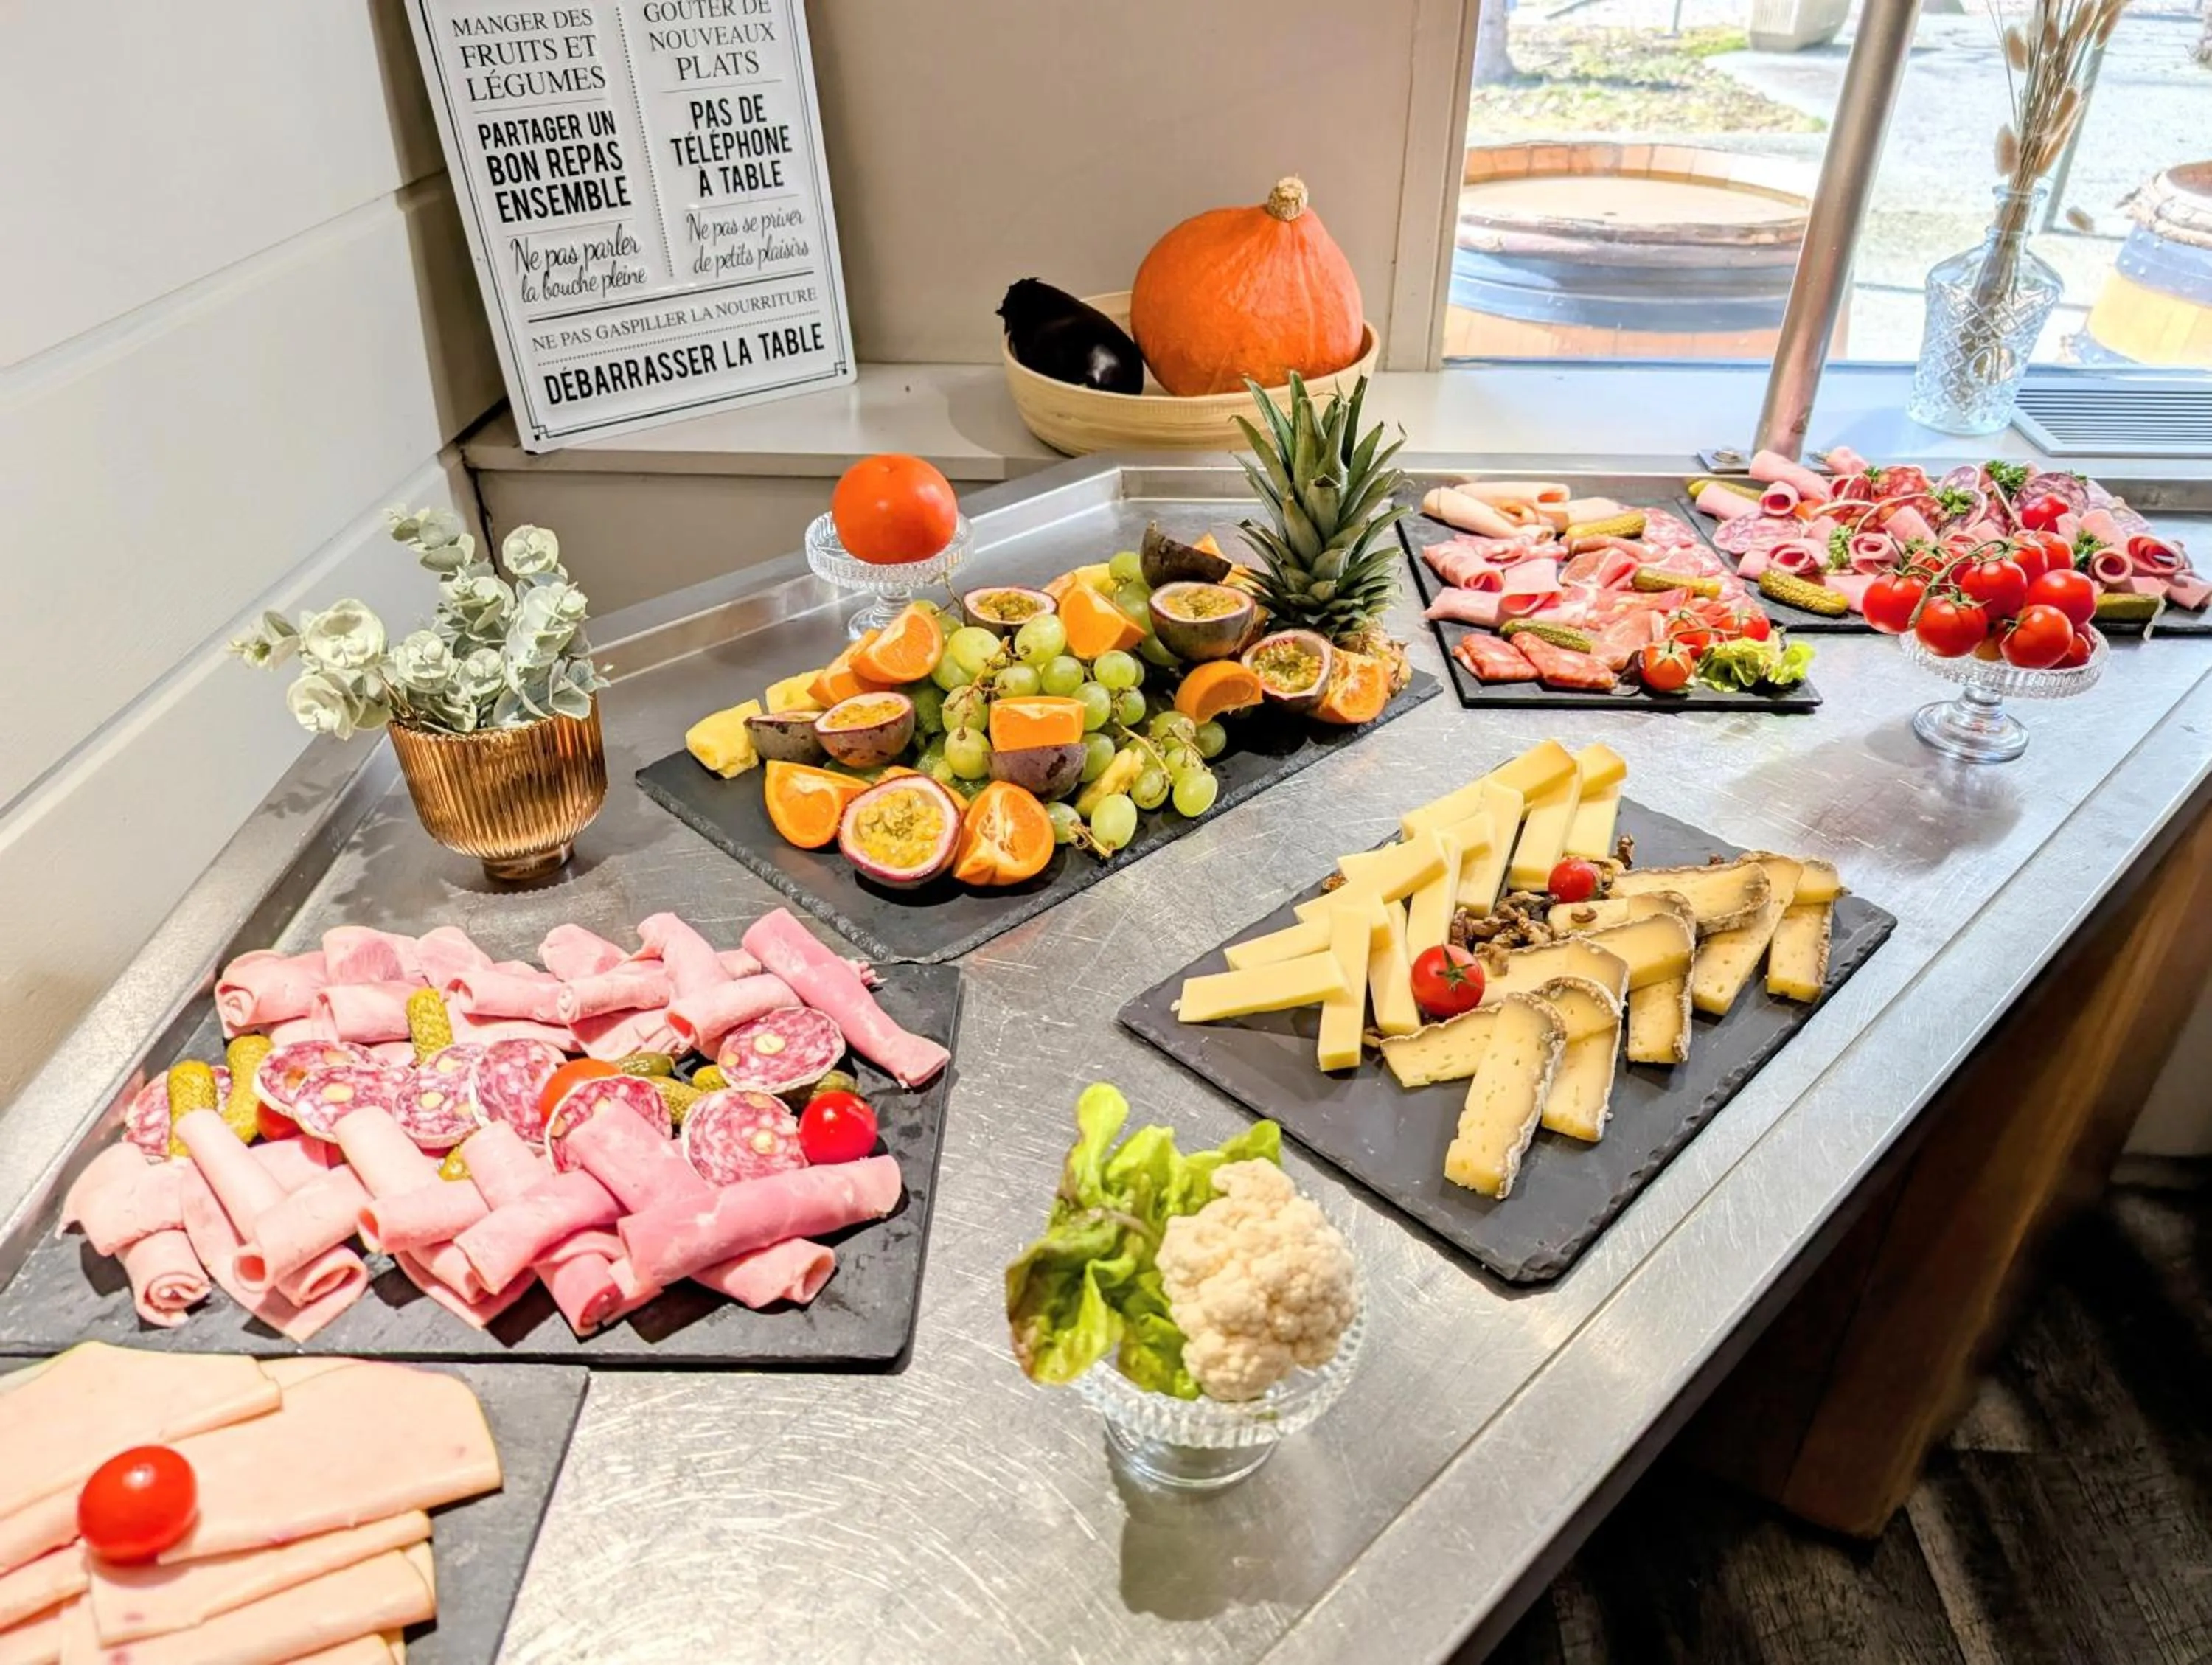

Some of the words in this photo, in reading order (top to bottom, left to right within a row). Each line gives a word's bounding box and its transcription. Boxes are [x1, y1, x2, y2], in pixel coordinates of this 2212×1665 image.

[451, 12, 549, 37] MANGER
[553, 8, 594, 29] DES
[742, 0, 772, 14] DE
[459, 38, 558, 69] FRUITS
[564, 35, 597, 59] ET
[649, 22, 776, 51] NOUVEAUX
[465, 66, 606, 102] LÉGUMES
[675, 50, 760, 81] PLATS
[477, 114, 583, 150] PARTAGER
[587, 110, 616, 136] UN
[689, 98, 733, 131] PAS
[738, 94, 767, 125] DE
[486, 150, 540, 186] BON
[545, 140, 623, 179] REPAS
[670, 125, 793, 167] TÉLÉPHONE
[718, 160, 784, 194] TABLE
[495, 175, 633, 223] ENSEMBLE
[686, 212, 709, 243] Ne
[712, 220, 740, 246] pas
[742, 217, 758, 233] se
[510, 237, 540, 275] Ne
[544, 245, 579, 280] pas
[583, 223, 641, 271] parler
[693, 244, 712, 274] de
[714, 240, 754, 278] petits
[521, 275, 540, 304] la
[543, 265, 599, 299] bouche
[601, 260, 647, 299] pleine
[532, 334, 558, 353] NE
[561, 328, 593, 347] PAS
[595, 313, 688, 341] GASPILLER
[691, 308, 714, 324] LA
[715, 288, 817, 315] NOURRITURE
[543, 344, 718, 406] DÉBARRASSER
[723, 336, 753, 369] LA
[758, 322, 825, 361] TABLE
